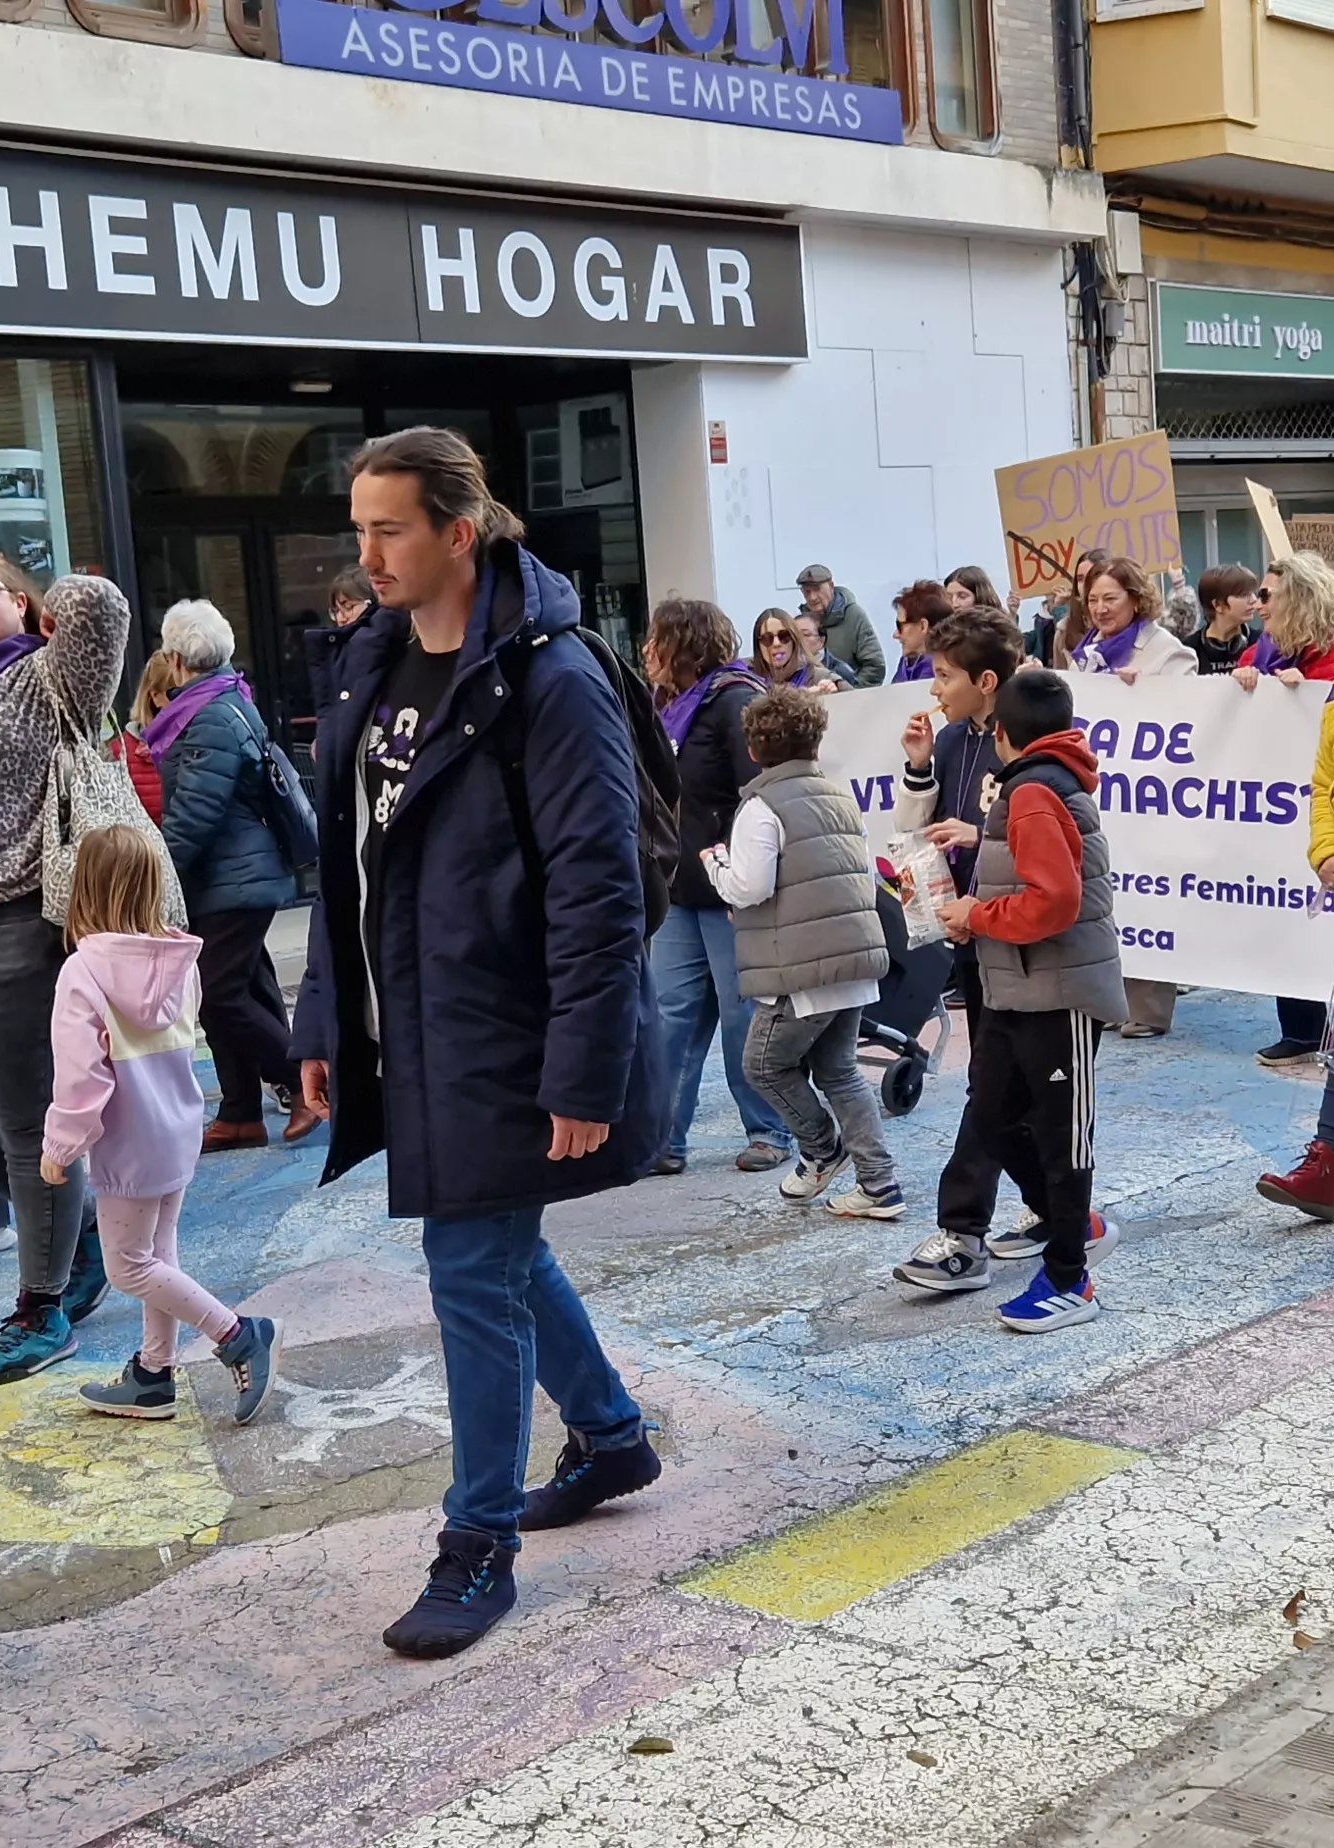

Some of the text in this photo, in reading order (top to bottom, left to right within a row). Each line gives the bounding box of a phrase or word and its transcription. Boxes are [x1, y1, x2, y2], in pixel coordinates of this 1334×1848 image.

[341, 18, 863, 130] ASESORIA DE EMPRESAS
[420, 224, 756, 328] HOGAR
[1185, 313, 1323, 360] maitri yoga
[1014, 440, 1167, 532] SOMOS
[1131, 721, 1195, 764] DE
